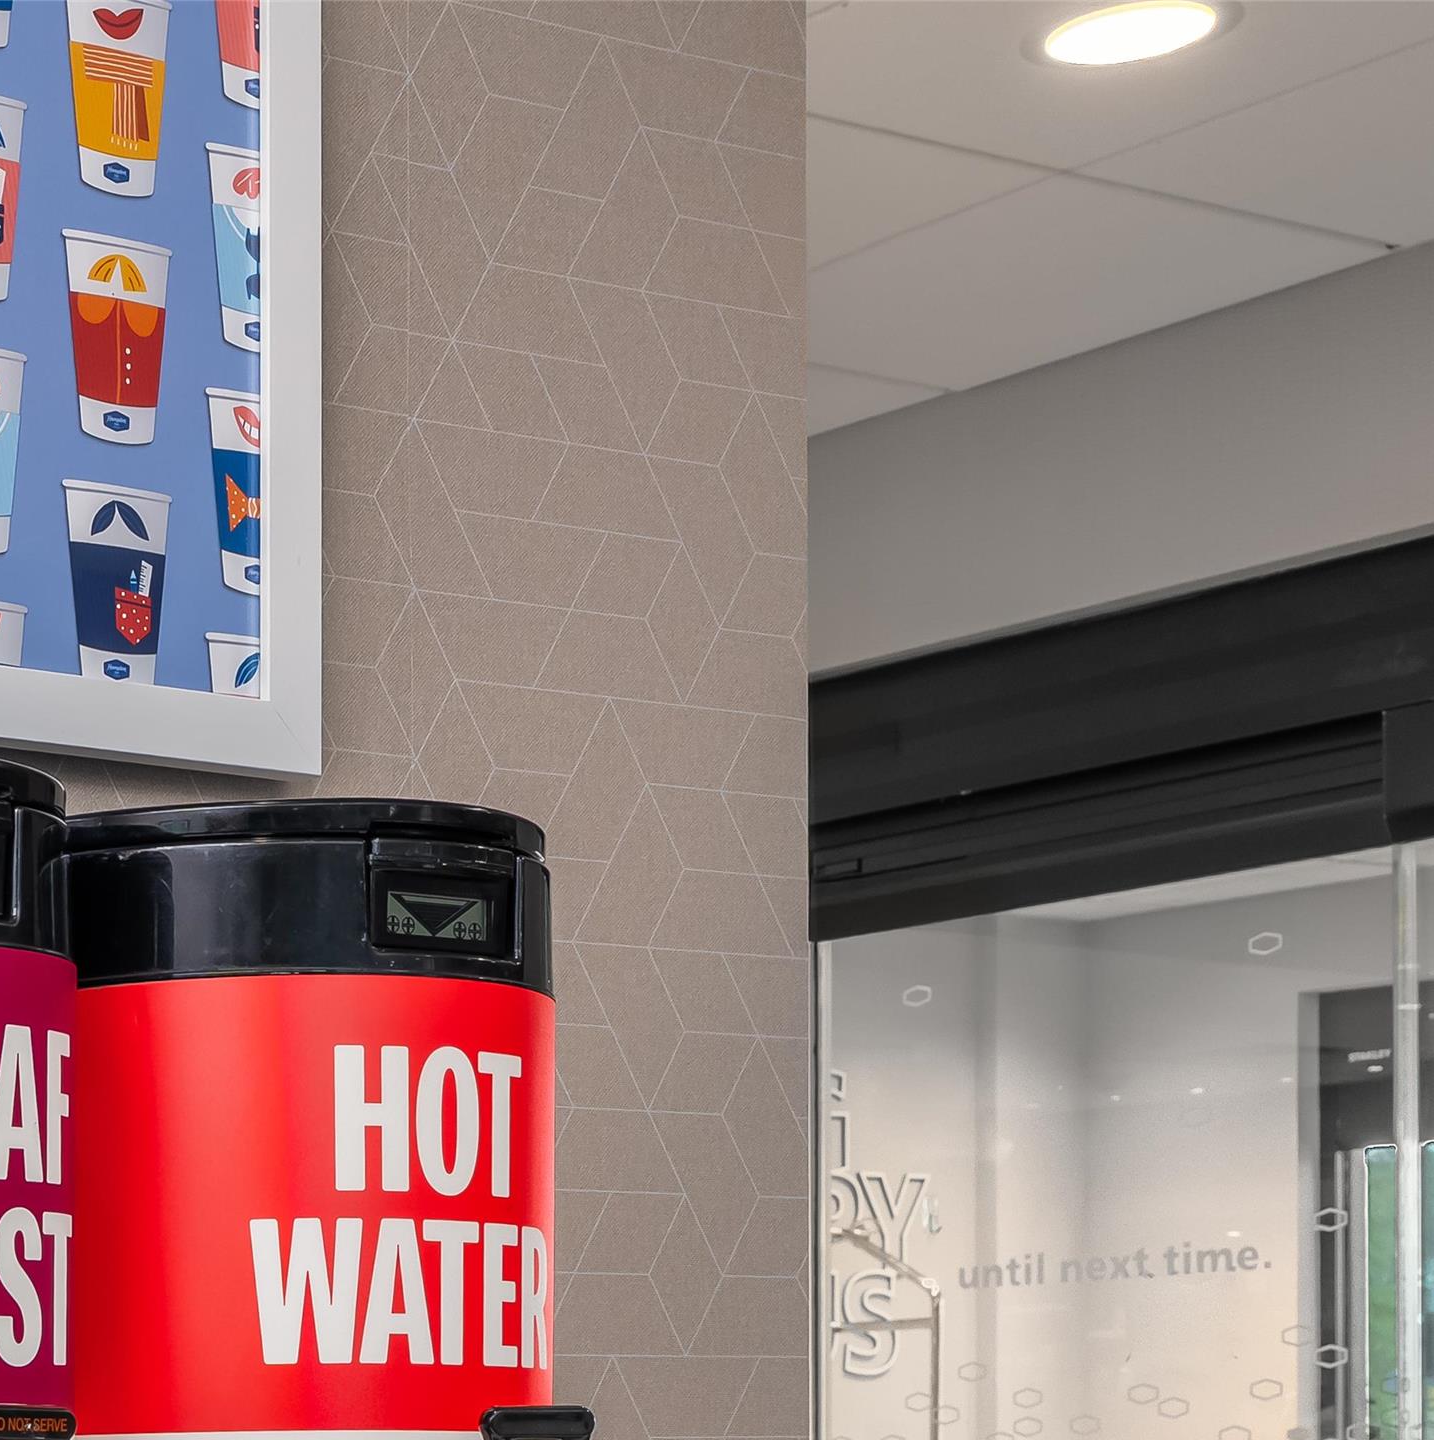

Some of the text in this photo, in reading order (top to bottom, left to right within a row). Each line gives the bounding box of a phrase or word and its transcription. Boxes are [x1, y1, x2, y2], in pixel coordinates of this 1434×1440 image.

[334, 1045, 522, 1198] HOT
[249, 1217, 548, 1370] WATER
[959, 1241, 1272, 1289] until next time.
[8, 1417, 31, 1432] NOT
[33, 1418, 68, 1432] SERVE
